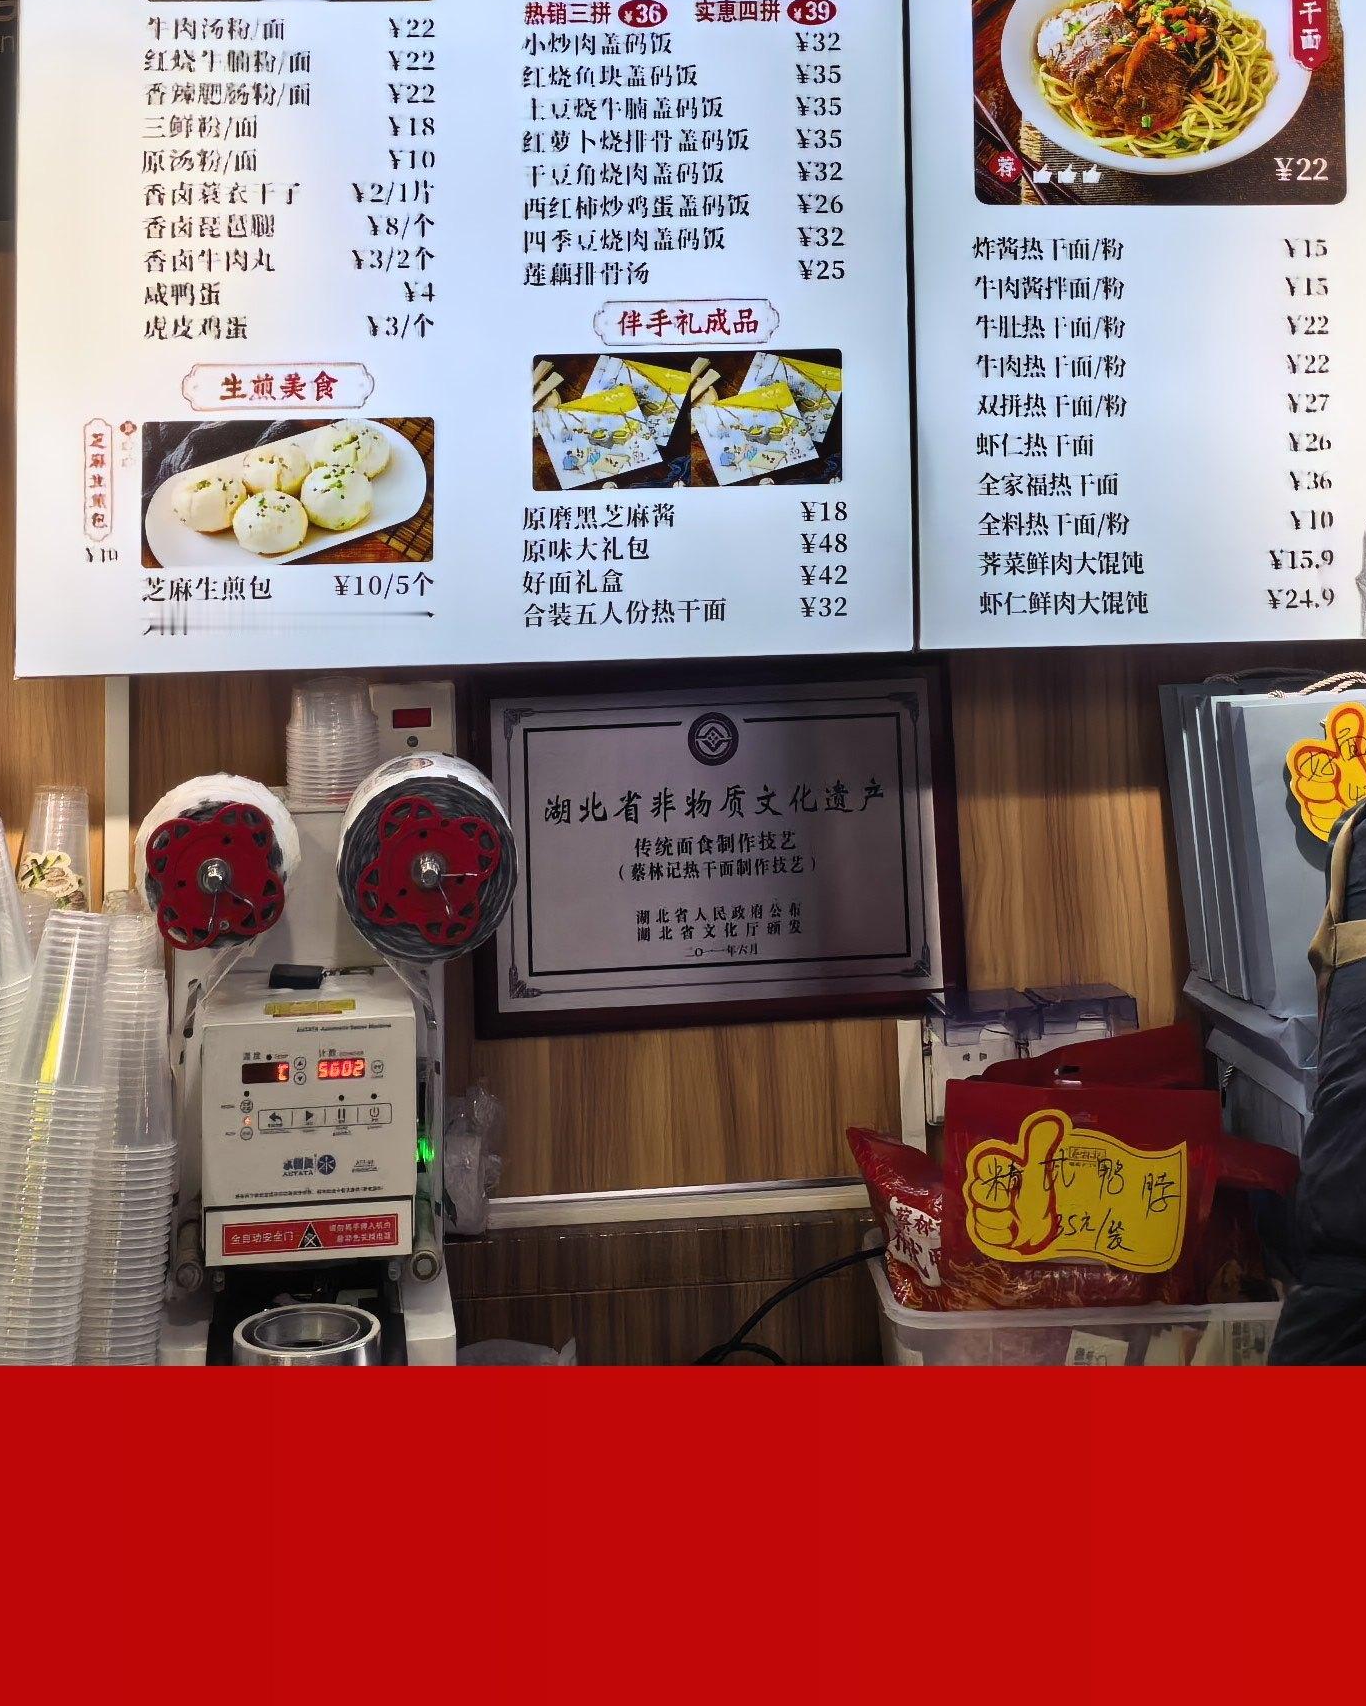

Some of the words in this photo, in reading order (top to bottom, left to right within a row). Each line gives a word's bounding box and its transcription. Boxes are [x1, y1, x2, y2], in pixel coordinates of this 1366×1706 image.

[524, 1, 612, 25] 热销三拼
[623, 2, 662, 25] ¥36
[695, 0, 781, 23] 实惠四拼
[793, 0, 832, 23] ¥39
[148, 17, 284, 41] 牛肉汤粉/面
[389, 18, 435, 38] ¥22
[522, 32, 671, 56] 小炒肉盖码饭
[796, 32, 840, 52] ¥32
[389, 50, 434, 71] ¥22
[522, 64, 697, 88] 红烧鱼块盖码饭
[796, 64, 841, 84] ¥35
[388, 84, 434, 103] ¥22
[796, 97, 841, 116] ¥35
[143, 114, 257, 140] 三鲜粉/面
[389, 117, 434, 136] ¥18
[522, 128, 749, 154] 红萝卜烧排骨盖码饭
[797, 129, 842, 149] ¥35
[142, 149, 256, 175] 原汤粉/面
[389, 149, 435, 169] ¥10
[526, 161, 723, 187] 干豆角烧肉盖码饭
[797, 161, 843, 181] ¥32
[1275, 157, 1328, 182] ¥22
[525, 194, 749, 220] 西红柿炒鸡蛋盖码饭
[797, 194, 843, 213] ¥26
[367, 213, 434, 238] ¥8/个
[523, 227, 725, 253] 四季豆烧肉盖码饭
[798, 226, 844, 247] ¥32
[973, 237, 1123, 261] 炸酱热干面/粉
[1285, 239, 1327, 258] ¥15
[145, 248, 275, 272] 香卤牛肉丸
[352, 246, 434, 271] ¥3/2个
[524, 262, 649, 286] 莲藕排骨汤
[798, 259, 844, 280] ¥25
[404, 281, 434, 302] ¥4
[975, 276, 1124, 300] 牛肉酱拌面/粉
[1286, 277, 1328, 296] ¥15
[144, 315, 247, 340] 虎皮鸡蛋
[368, 313, 434, 338] ¥3/个
[617, 307, 759, 337] 伴手礼成品
[976, 315, 1125, 339] 牛肚热干面/粉
[1287, 315, 1328, 335] ¥22
[976, 354, 1126, 379] 牛肉热干面/粉
[1287, 354, 1329, 374] ¥22
[219, 370, 339, 401] 生煎美食
[978, 393, 1126, 418] 双拼热干面/粉
[1288, 393, 1329, 413] ¥27
[976, 433, 1093, 457] 虾仁热干面
[1289, 432, 1331, 452] ¥26
[978, 473, 1117, 496] 全家福热干面
[1290, 471, 1332, 490] ¥36
[523, 503, 674, 530] 原磨黑芝麻酱
[801, 501, 847, 521] ¥18
[978, 512, 1129, 538] 全料热干面/粉
[1290, 510, 1333, 530] ¥10
[523, 536, 649, 563] 原味大礼包
[800, 533, 847, 553] ¥48
[977, 551, 1144, 576] 荠菜鲜肉大馄饨
[1269, 550, 1333, 570] ¥15.9
[142, 575, 272, 602] 芝麻生煎包
[335, 572, 434, 599] ¥10/5个
[523, 569, 623, 595] 好面礼盒
[800, 565, 847, 585] ¥42
[524, 594, 726, 627] 合装五人份热干面
[801, 597, 847, 617] ¥32
[980, 591, 1148, 615] 虾仁鲜肉大馄饨
[1267, 588, 1334, 609] ¥24.9
[544, 777, 885, 825] 湖北省非物质文化遗产
[634, 830, 797, 858] 传统面食制作技艺
[636, 901, 801, 926] 湖北省人民政府公布
[637, 919, 802, 943] 湖北省文化厅颁发
